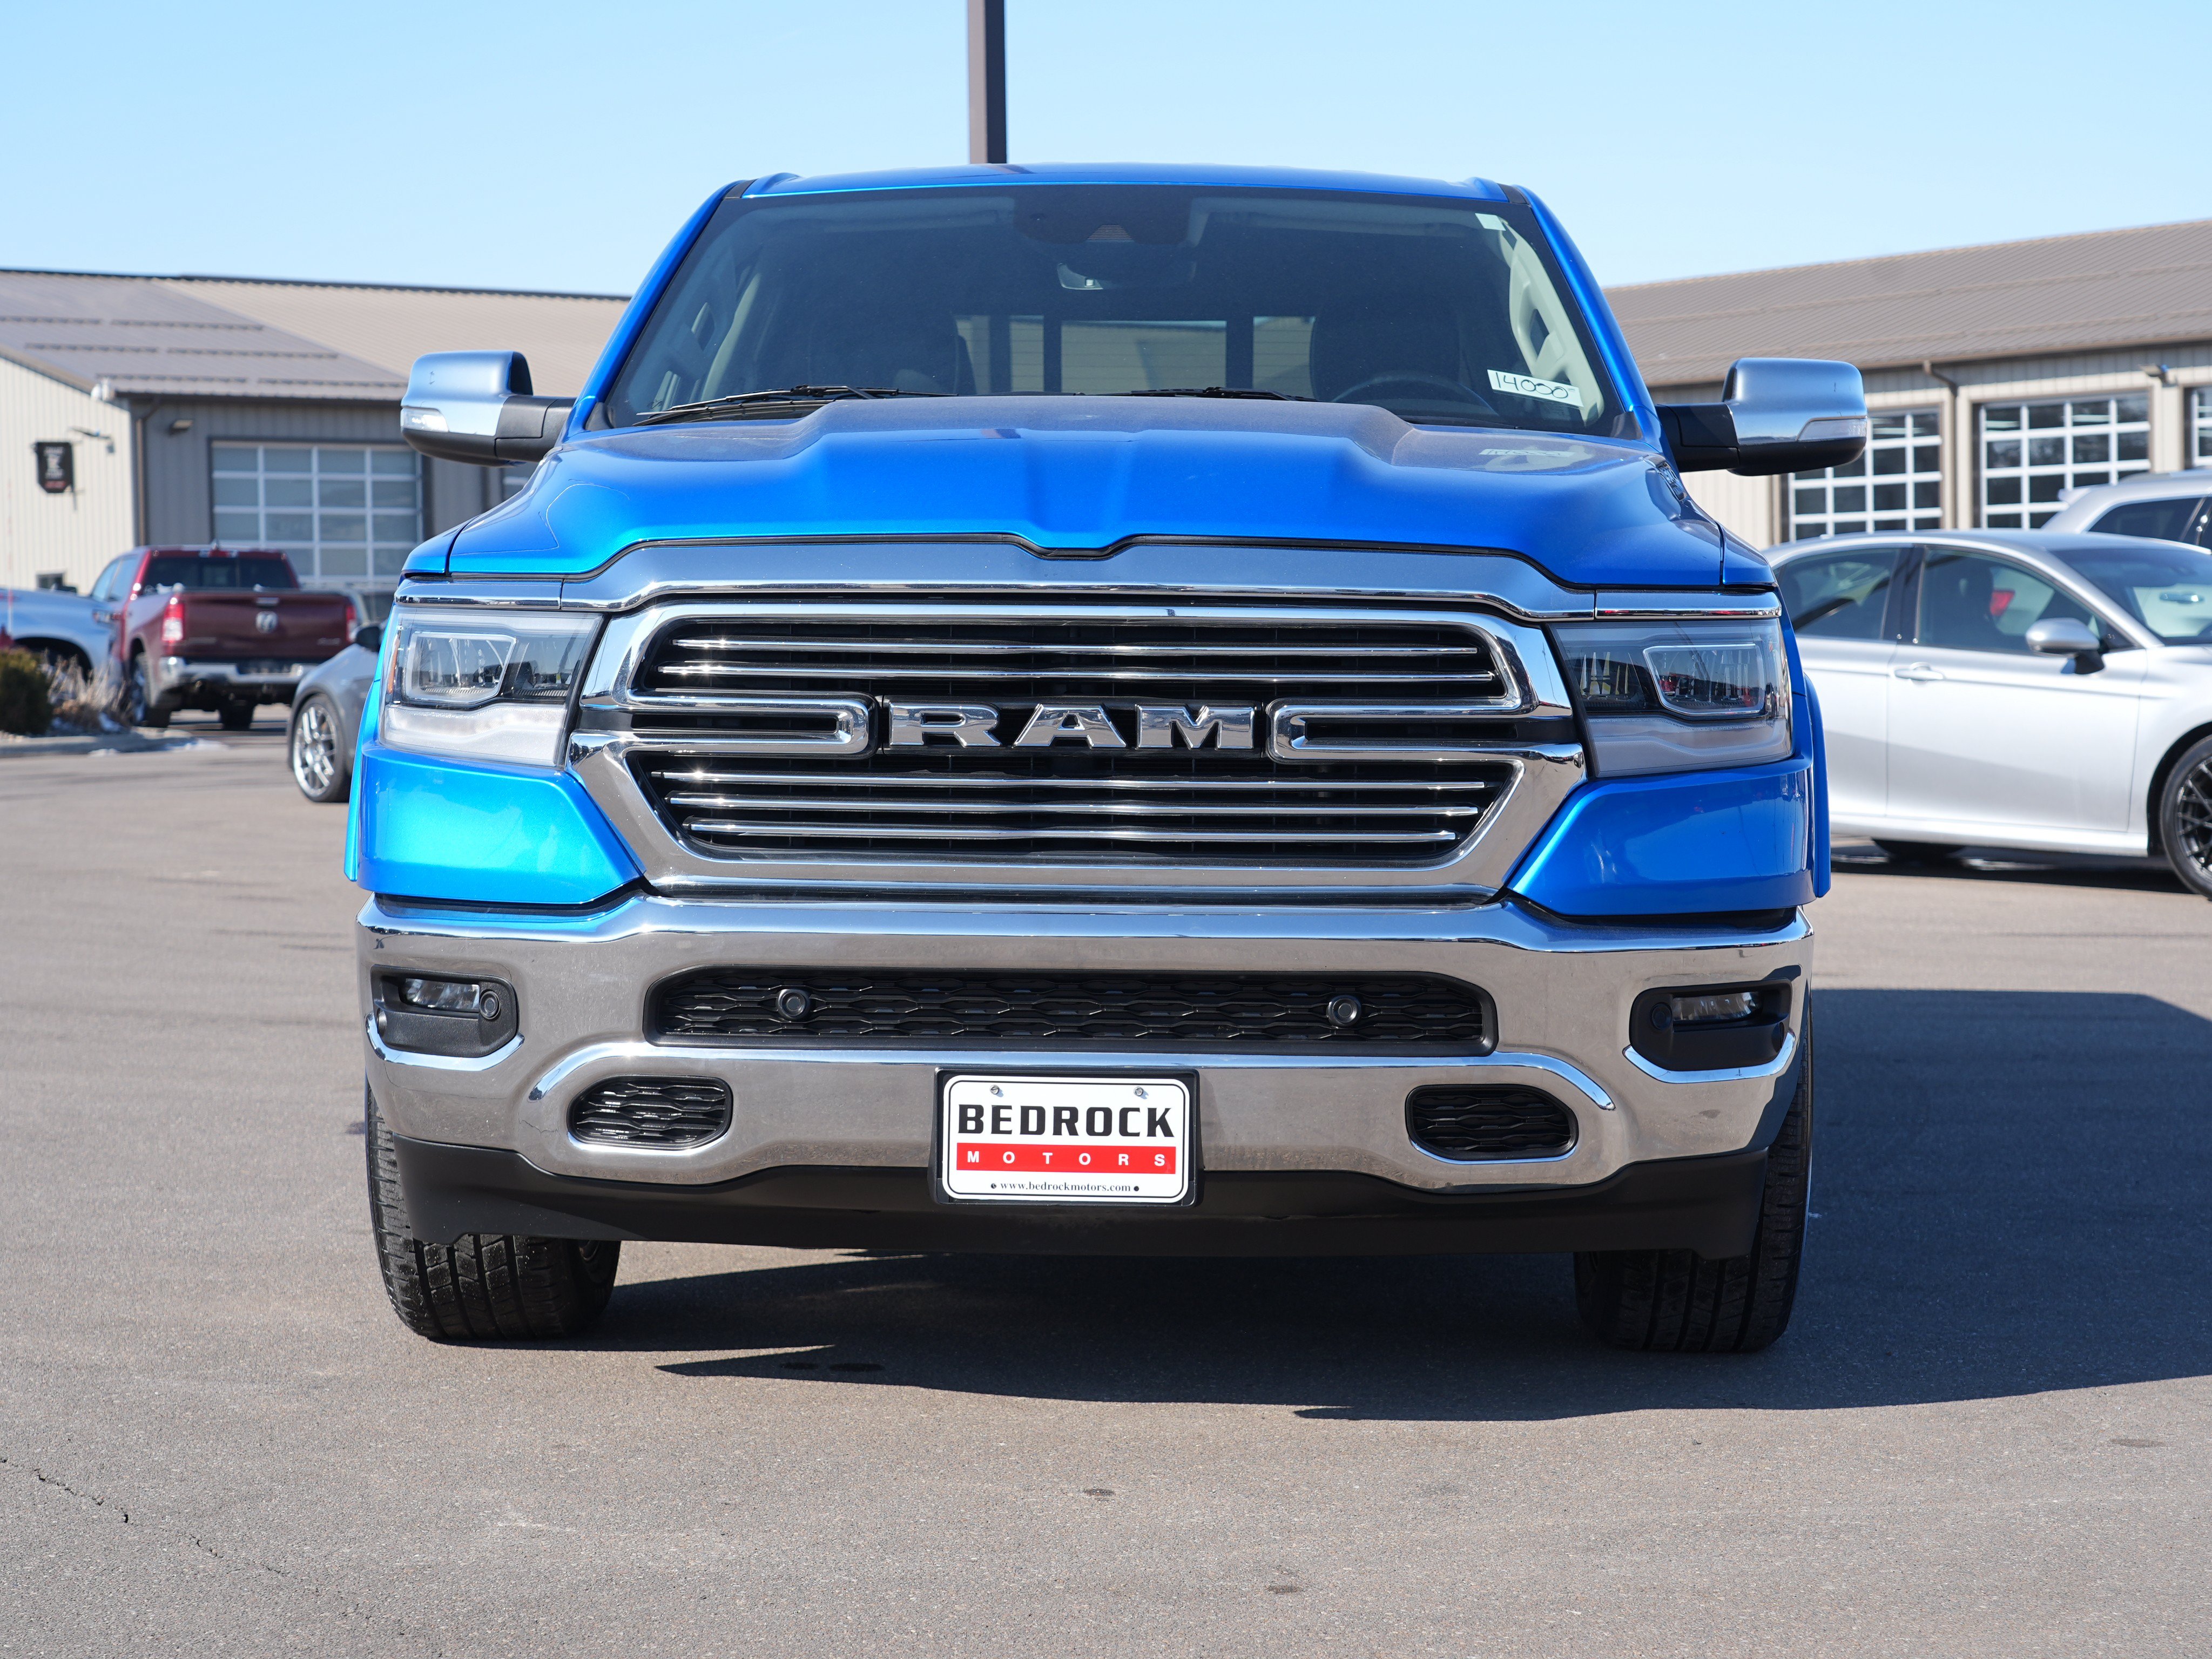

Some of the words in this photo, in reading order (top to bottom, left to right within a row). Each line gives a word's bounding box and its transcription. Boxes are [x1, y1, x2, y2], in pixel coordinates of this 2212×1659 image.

[889, 703, 1256, 749] RAM
[958, 1104, 1174, 1137] BEDROCK
[967, 1151, 1165, 1166] MOTORS
[1000, 1182, 1131, 1192] www.bedrockmotors.com
